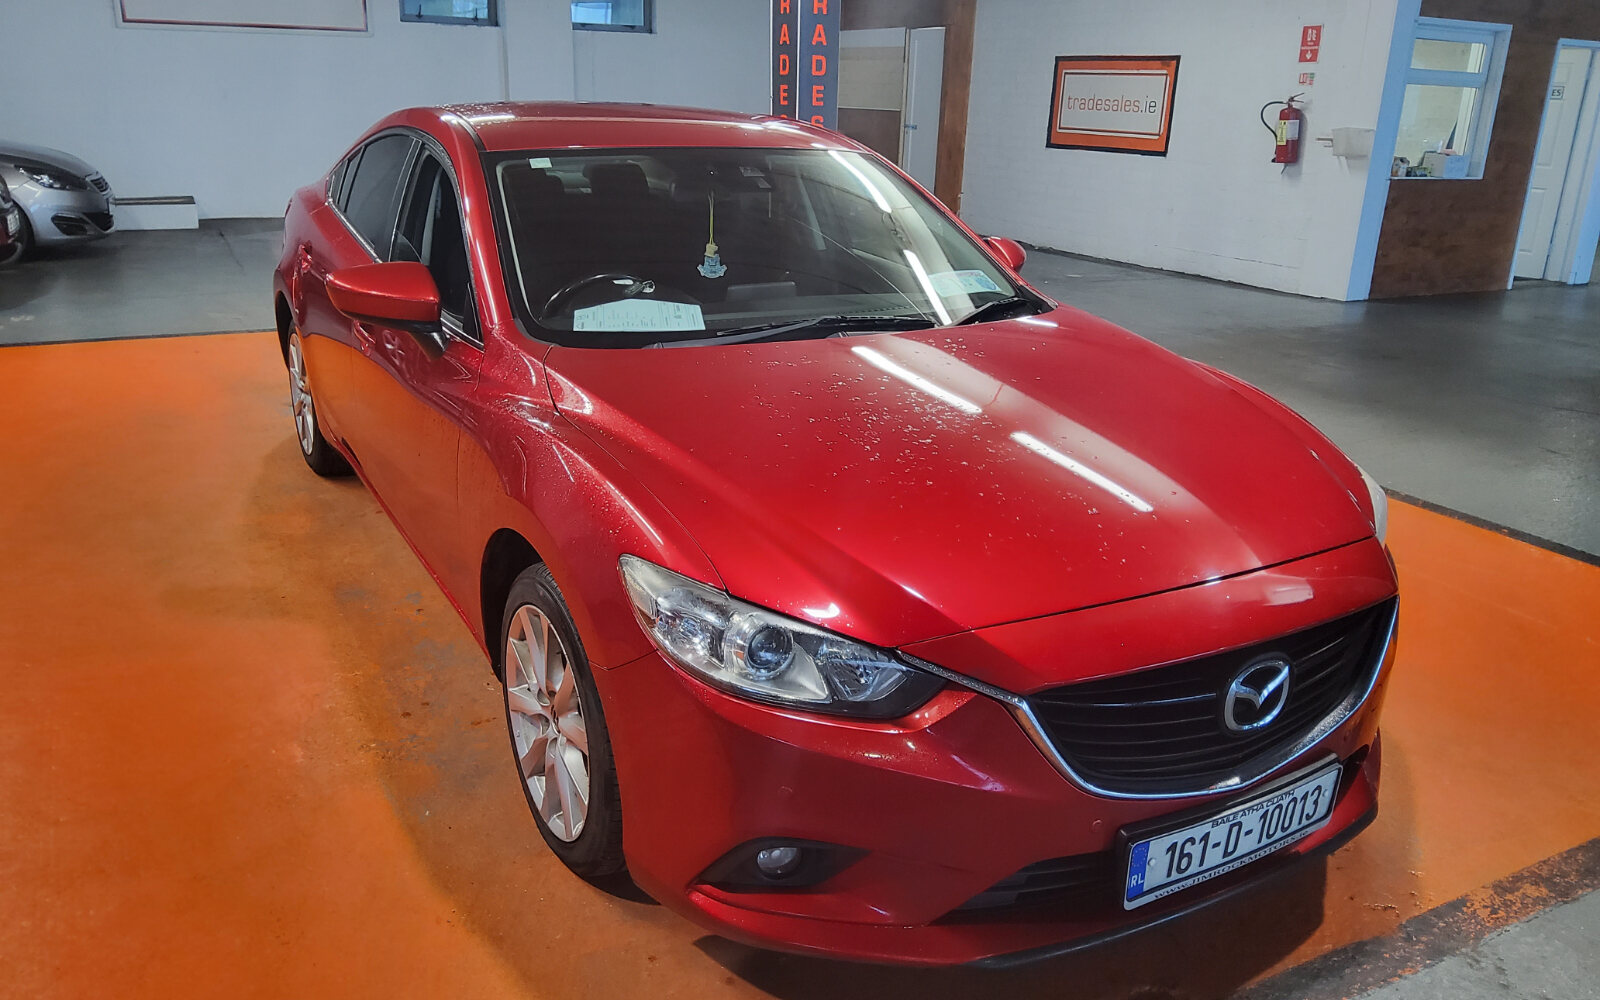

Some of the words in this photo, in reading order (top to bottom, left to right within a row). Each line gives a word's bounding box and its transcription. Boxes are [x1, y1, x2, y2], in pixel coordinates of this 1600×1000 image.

[779, 0, 791, 119] RADE
[1067, 93, 1157, 114] tradesales.ie
[1165, 784, 1323, 879] 161-D-10013
[1211, 813, 1240, 828] BAILE
